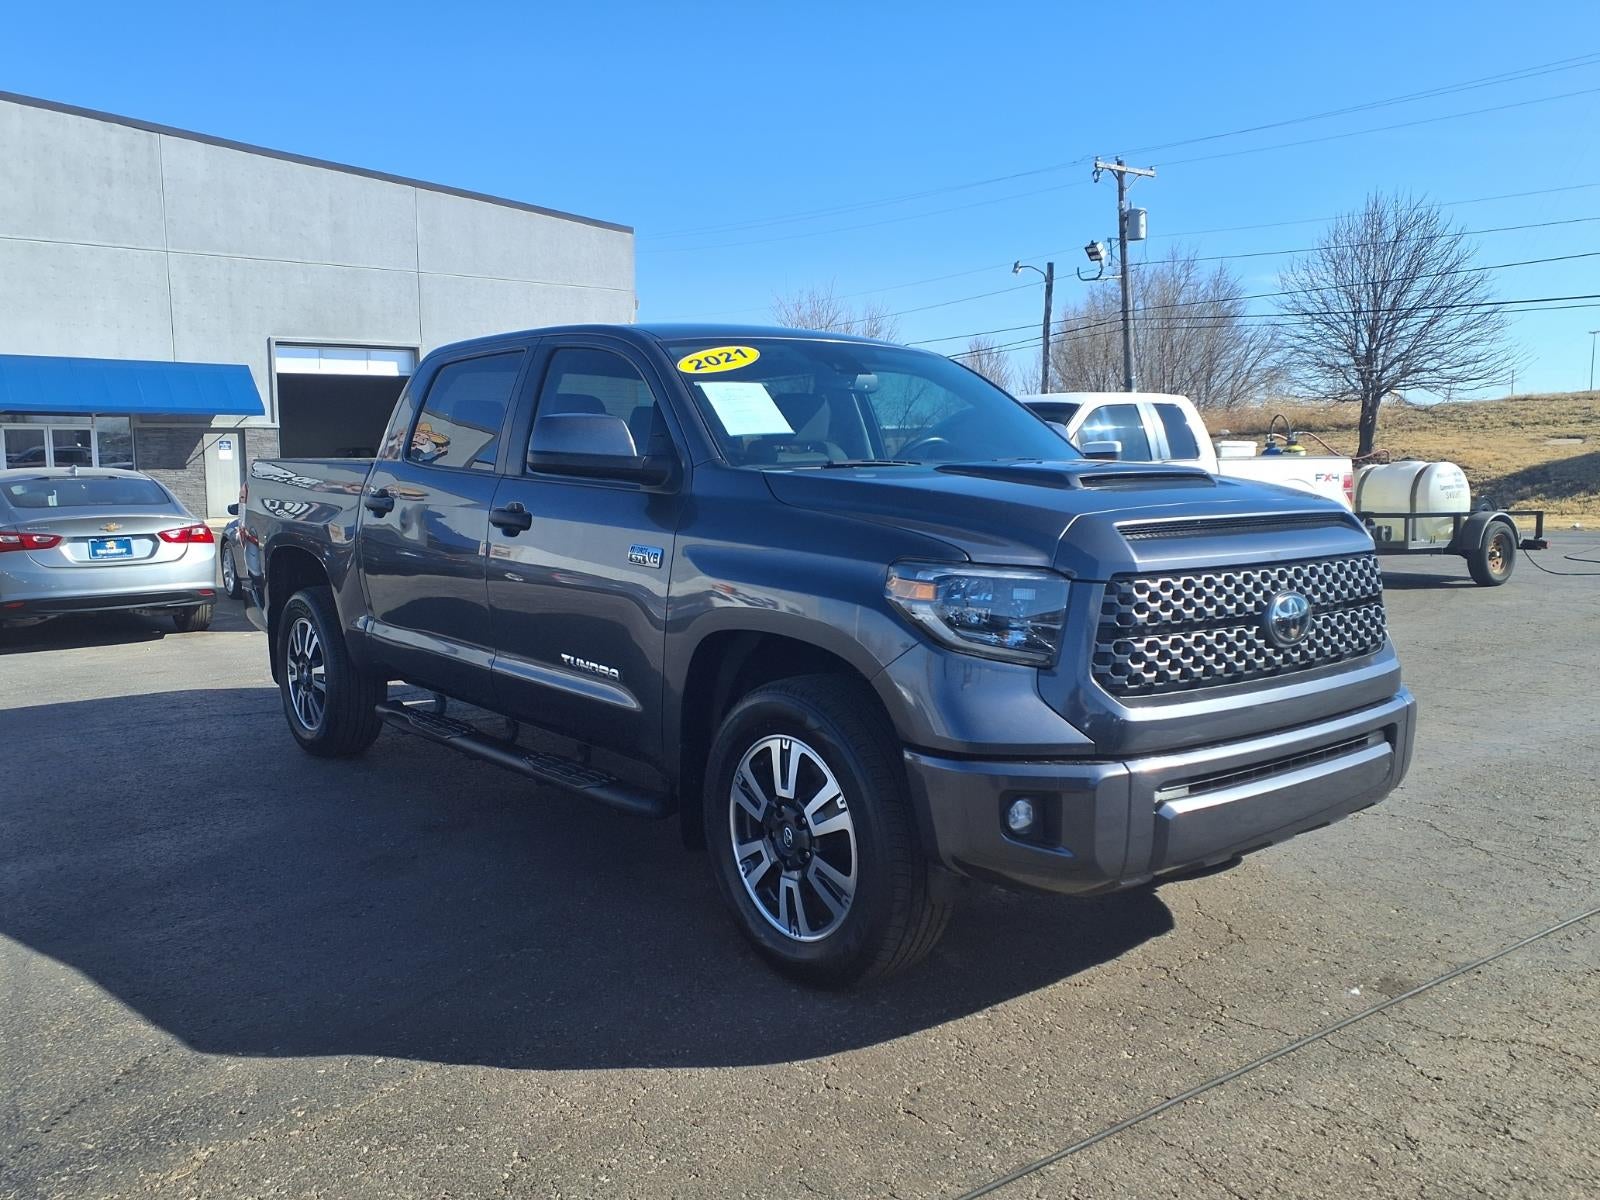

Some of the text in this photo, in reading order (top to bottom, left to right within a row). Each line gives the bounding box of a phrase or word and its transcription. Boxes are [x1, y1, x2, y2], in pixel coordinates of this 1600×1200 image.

[688, 348, 748, 371] 2021
[1315, 473, 1339, 482] FX4
[647, 551, 659, 564] V8
[560, 653, 619, 678] TUNDRA
